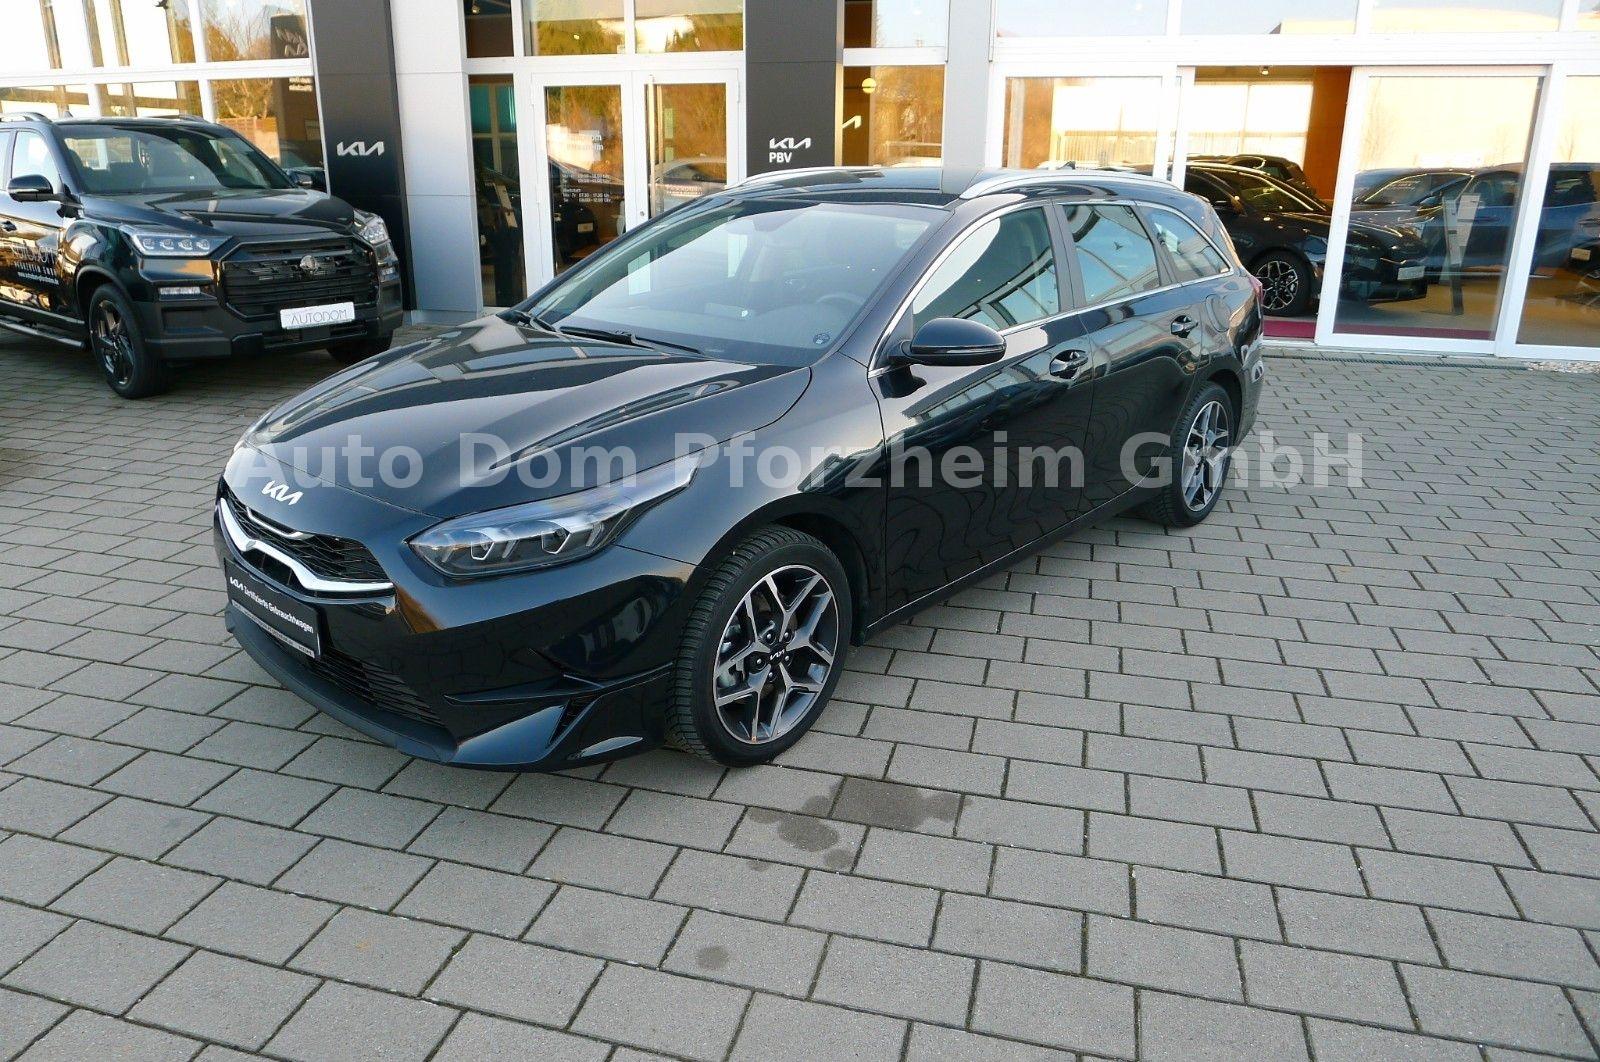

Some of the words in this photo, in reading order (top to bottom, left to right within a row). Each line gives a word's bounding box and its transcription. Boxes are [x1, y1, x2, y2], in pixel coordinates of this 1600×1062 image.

[336, 141, 385, 157] KIA
[769, 137, 811, 149] KIA
[769, 152, 792, 163] PBV
[291, 309, 347, 325] AUTODOM
[261, 480, 304, 506] KIA
[268, 602, 314, 634] Gebrauchtwagen
